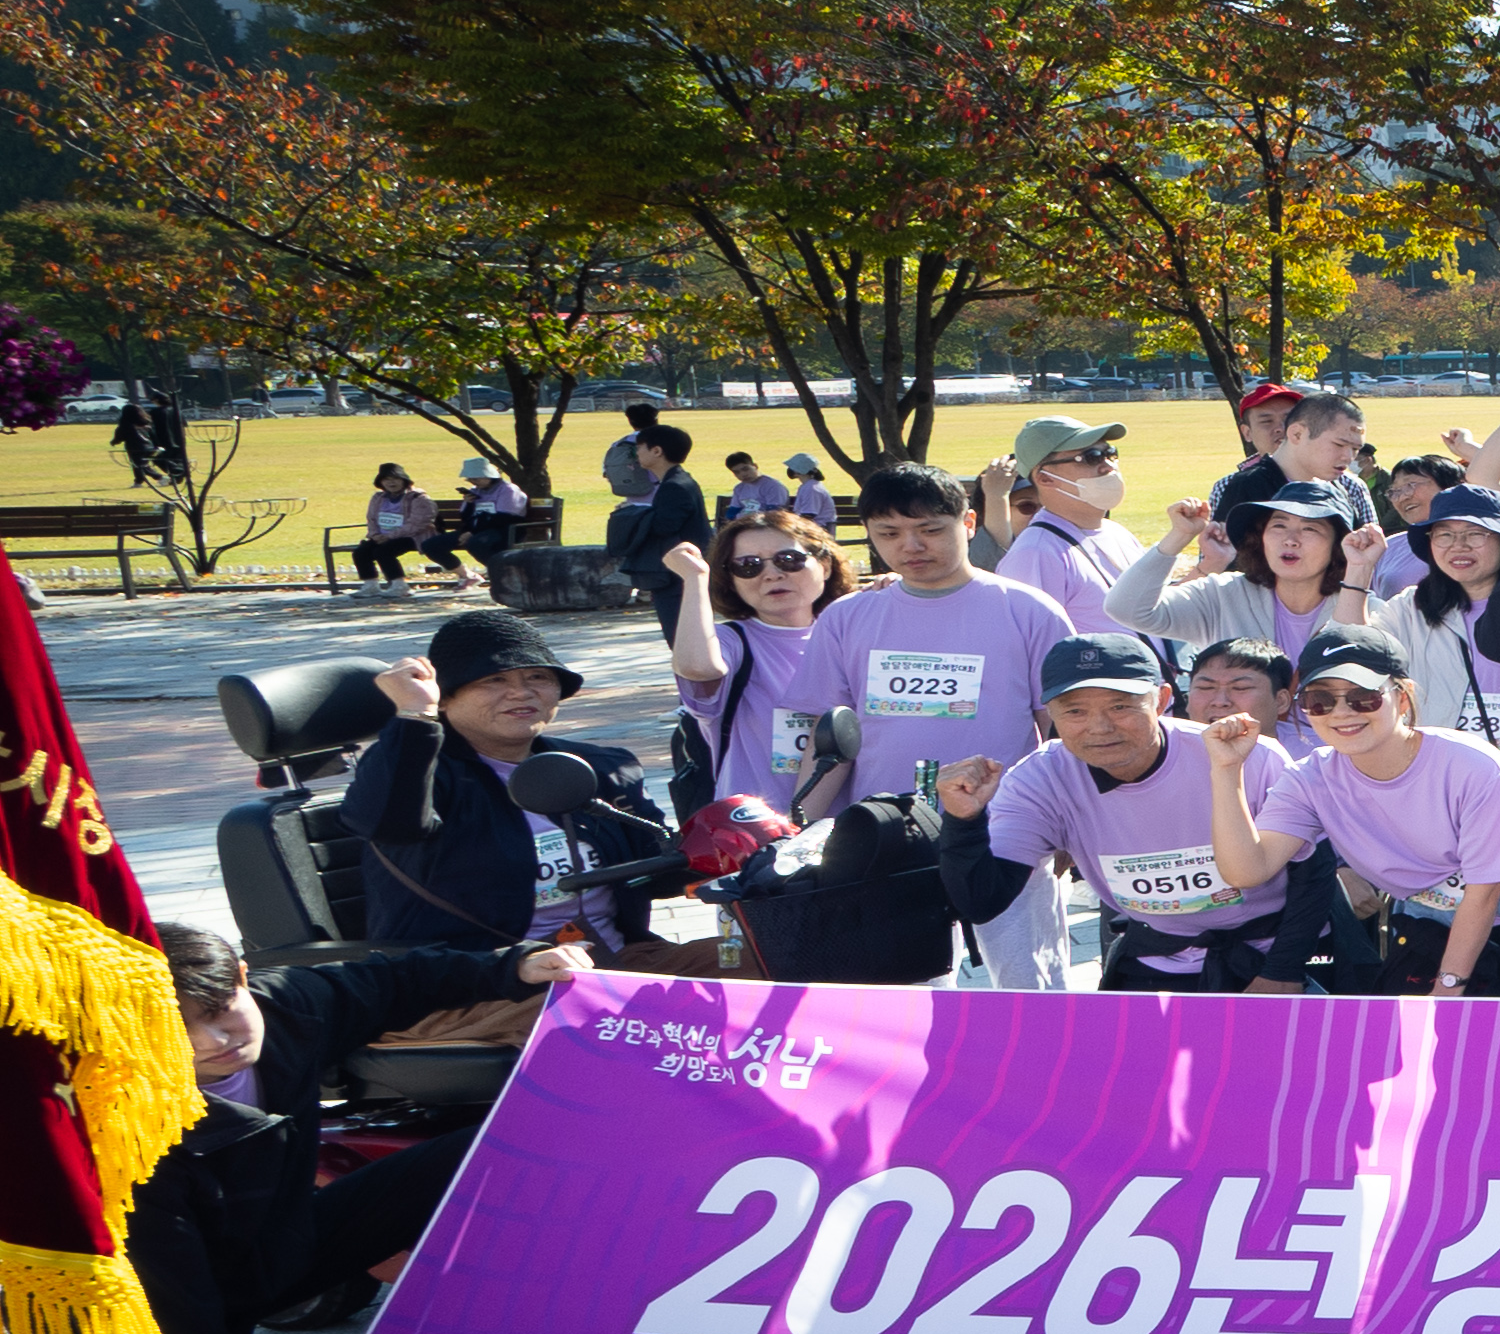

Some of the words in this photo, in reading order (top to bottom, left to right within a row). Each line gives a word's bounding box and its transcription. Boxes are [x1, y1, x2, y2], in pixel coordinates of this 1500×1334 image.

[880, 661, 932, 671] 발달장애인
[889, 676, 958, 696] 0223
[1456, 716, 1500, 733] 238
[1113, 860, 1172, 873] 발달장애인
[1174, 855, 1215, 867] 트레킹대
[1132, 872, 1213, 895] 0516
[595, 1016, 664, 1049] 첨단과
[661, 1021, 722, 1054] 혁신의
[653, 1052, 737, 1086] 희망도시
[727, 1026, 834, 1090] 성남
